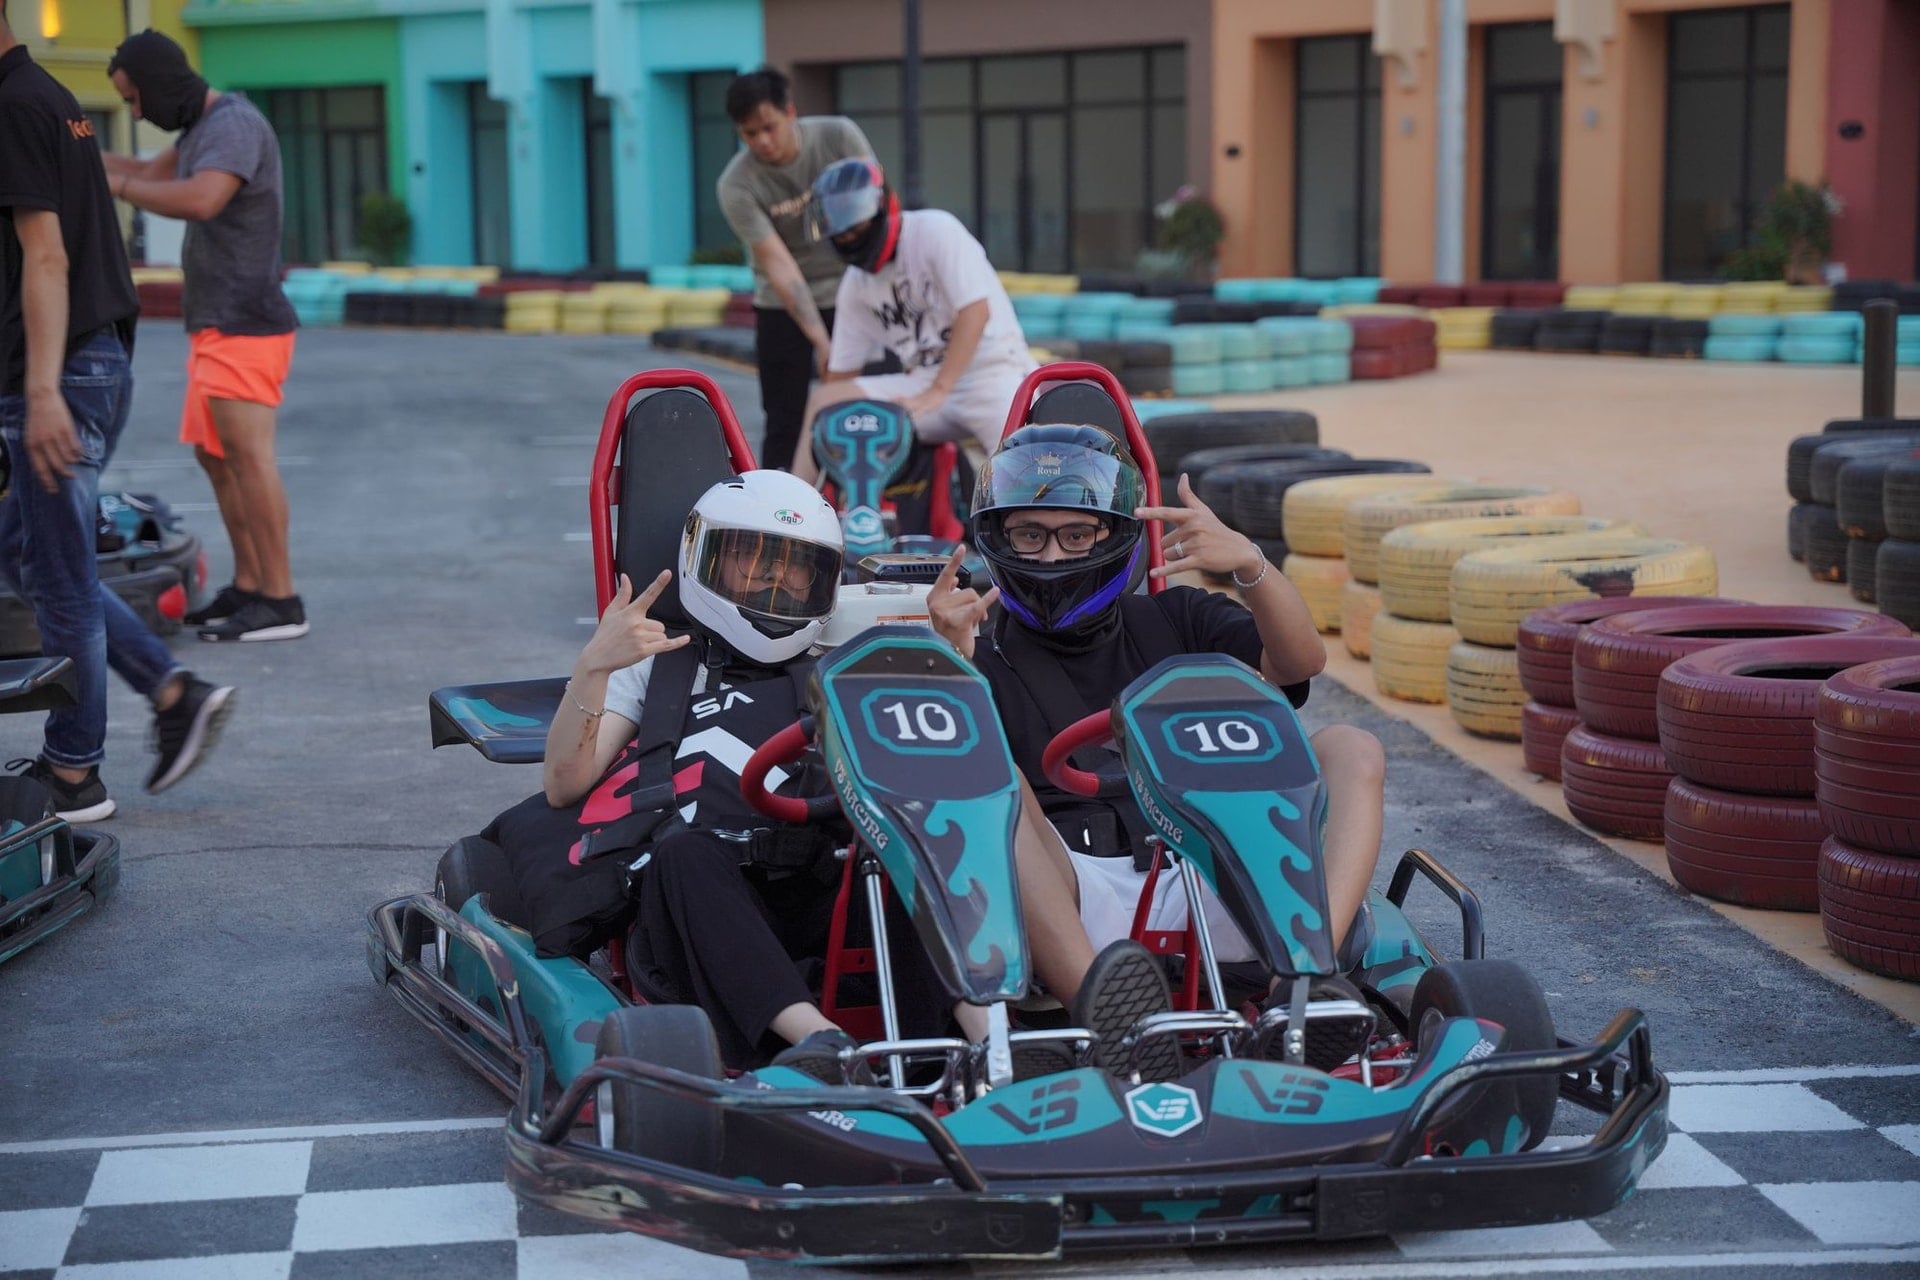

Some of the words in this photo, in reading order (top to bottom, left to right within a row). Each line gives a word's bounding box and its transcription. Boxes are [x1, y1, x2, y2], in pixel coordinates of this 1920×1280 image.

[1037, 466, 1061, 477] Royal
[882, 701, 957, 741] 10
[1183, 720, 1260, 752] 10
